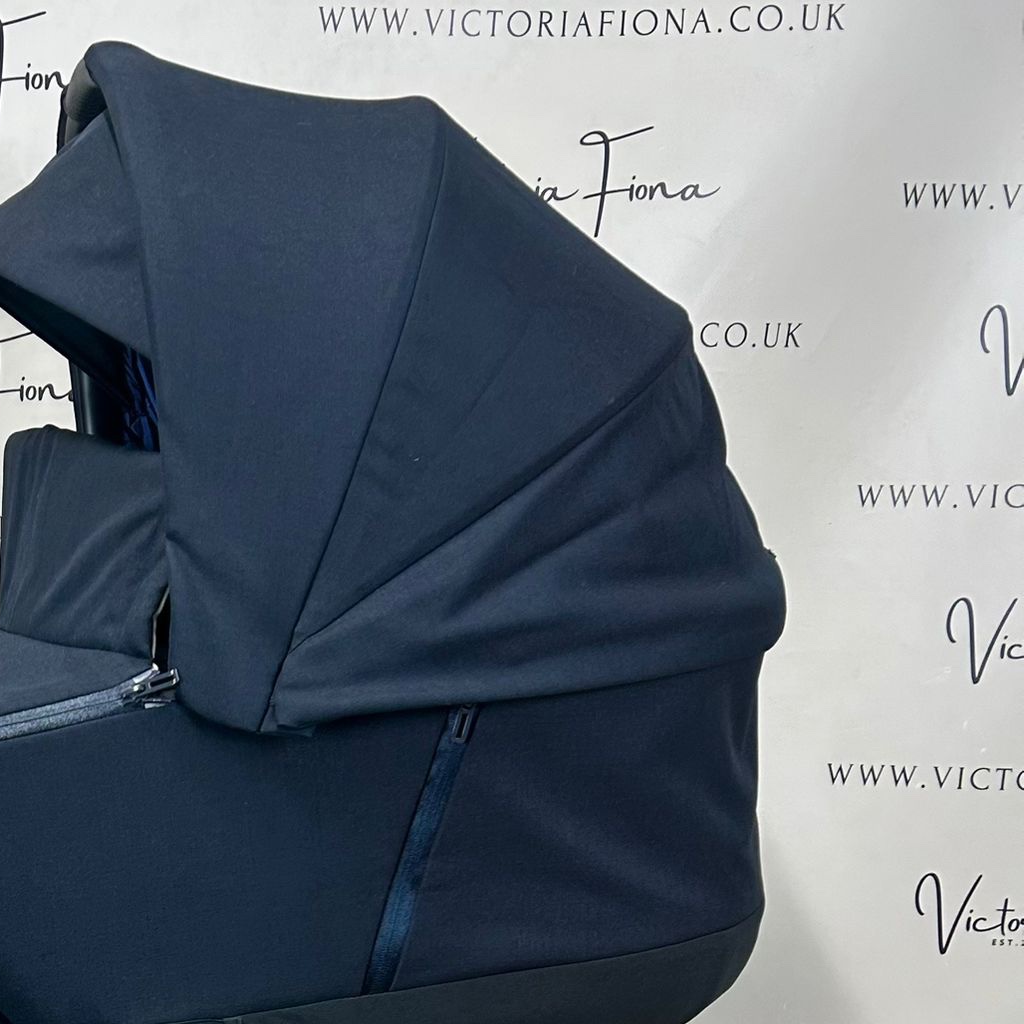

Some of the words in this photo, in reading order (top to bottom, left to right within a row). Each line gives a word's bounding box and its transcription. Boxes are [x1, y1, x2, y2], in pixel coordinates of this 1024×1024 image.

[319, 3, 846, 39] WWW.VICTORIAFIONA.CO.UK
[579, 126, 721, 238] Fiona
[915, 872, 1024, 956] Victo
